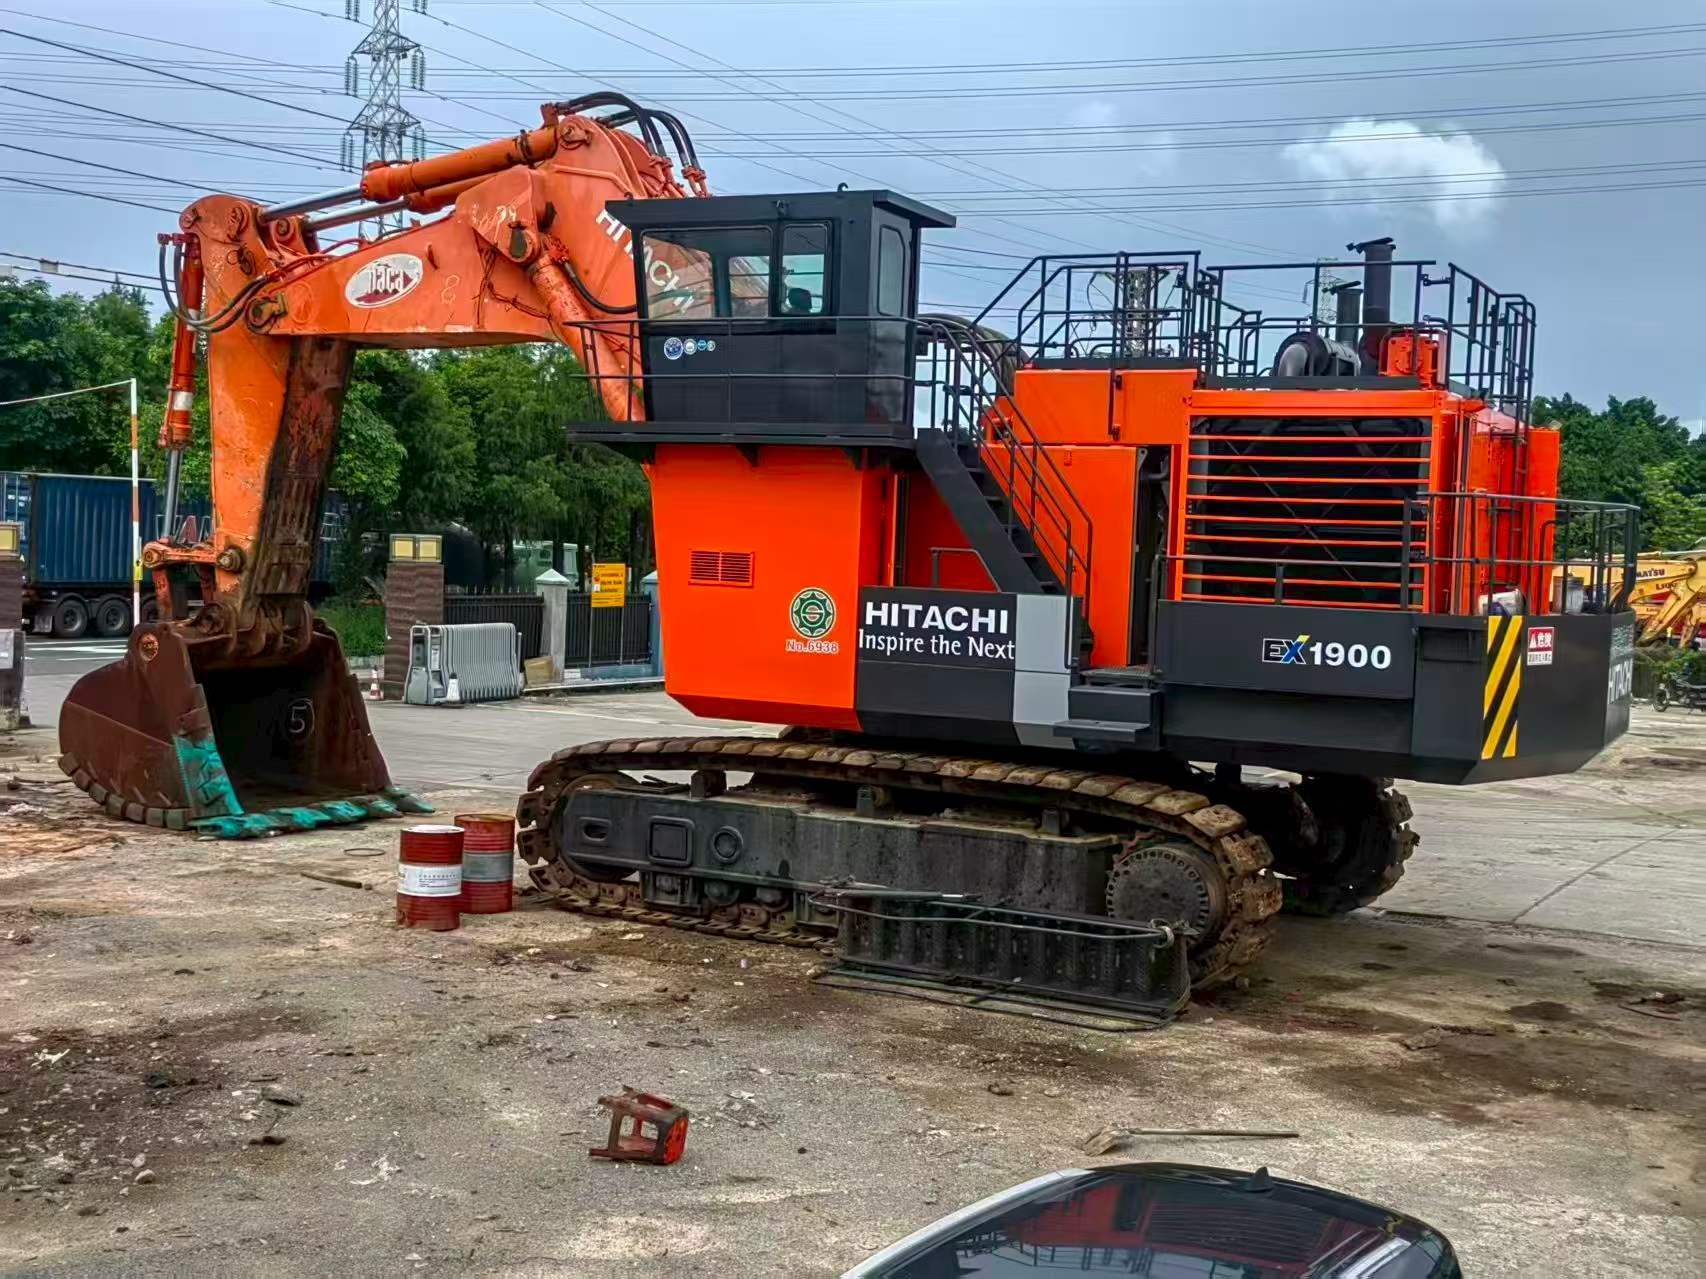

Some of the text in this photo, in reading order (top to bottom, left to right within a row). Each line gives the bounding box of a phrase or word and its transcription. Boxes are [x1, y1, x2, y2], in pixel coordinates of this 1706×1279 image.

[865, 601, 1008, 634] HITACHI
[858, 628, 1015, 660] Inspire the Next
[289, 706, 305, 733] 5
